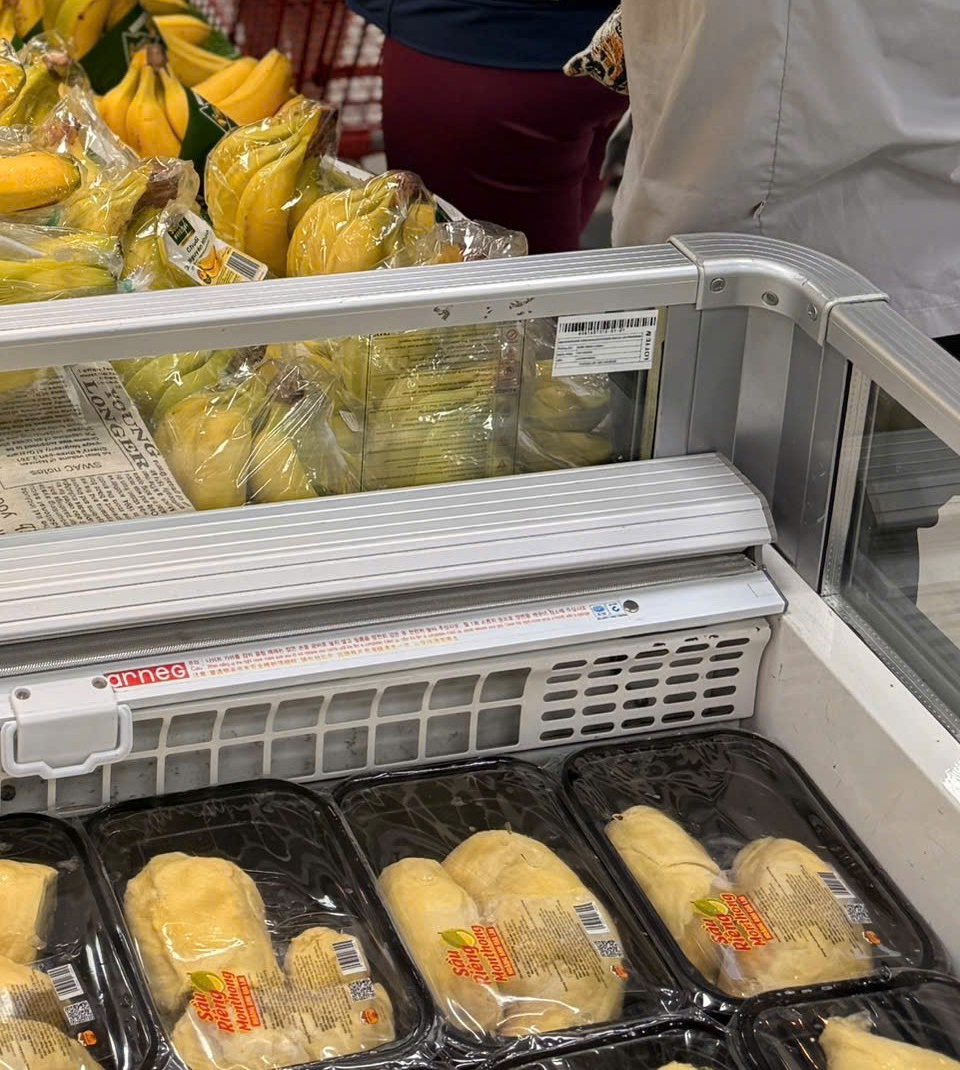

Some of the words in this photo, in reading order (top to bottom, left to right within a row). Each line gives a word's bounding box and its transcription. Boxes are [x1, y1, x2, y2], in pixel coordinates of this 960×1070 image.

[83, 380, 148, 469] LONGER
[103, 387, 160, 457] YOUNG
[702, 918, 729, 944] Sầu
[715, 914, 751, 951] Riêng
[721, 894, 766, 946] Monthong
[445, 950, 470, 976] Sầu
[462, 945, 492, 984] Riêng
[471, 925, 507, 981] Monthong
[190, 992, 214, 1021] Sầu
[209, 990, 235, 1032] Riêng
[222, 971, 251, 1030] Monthong
